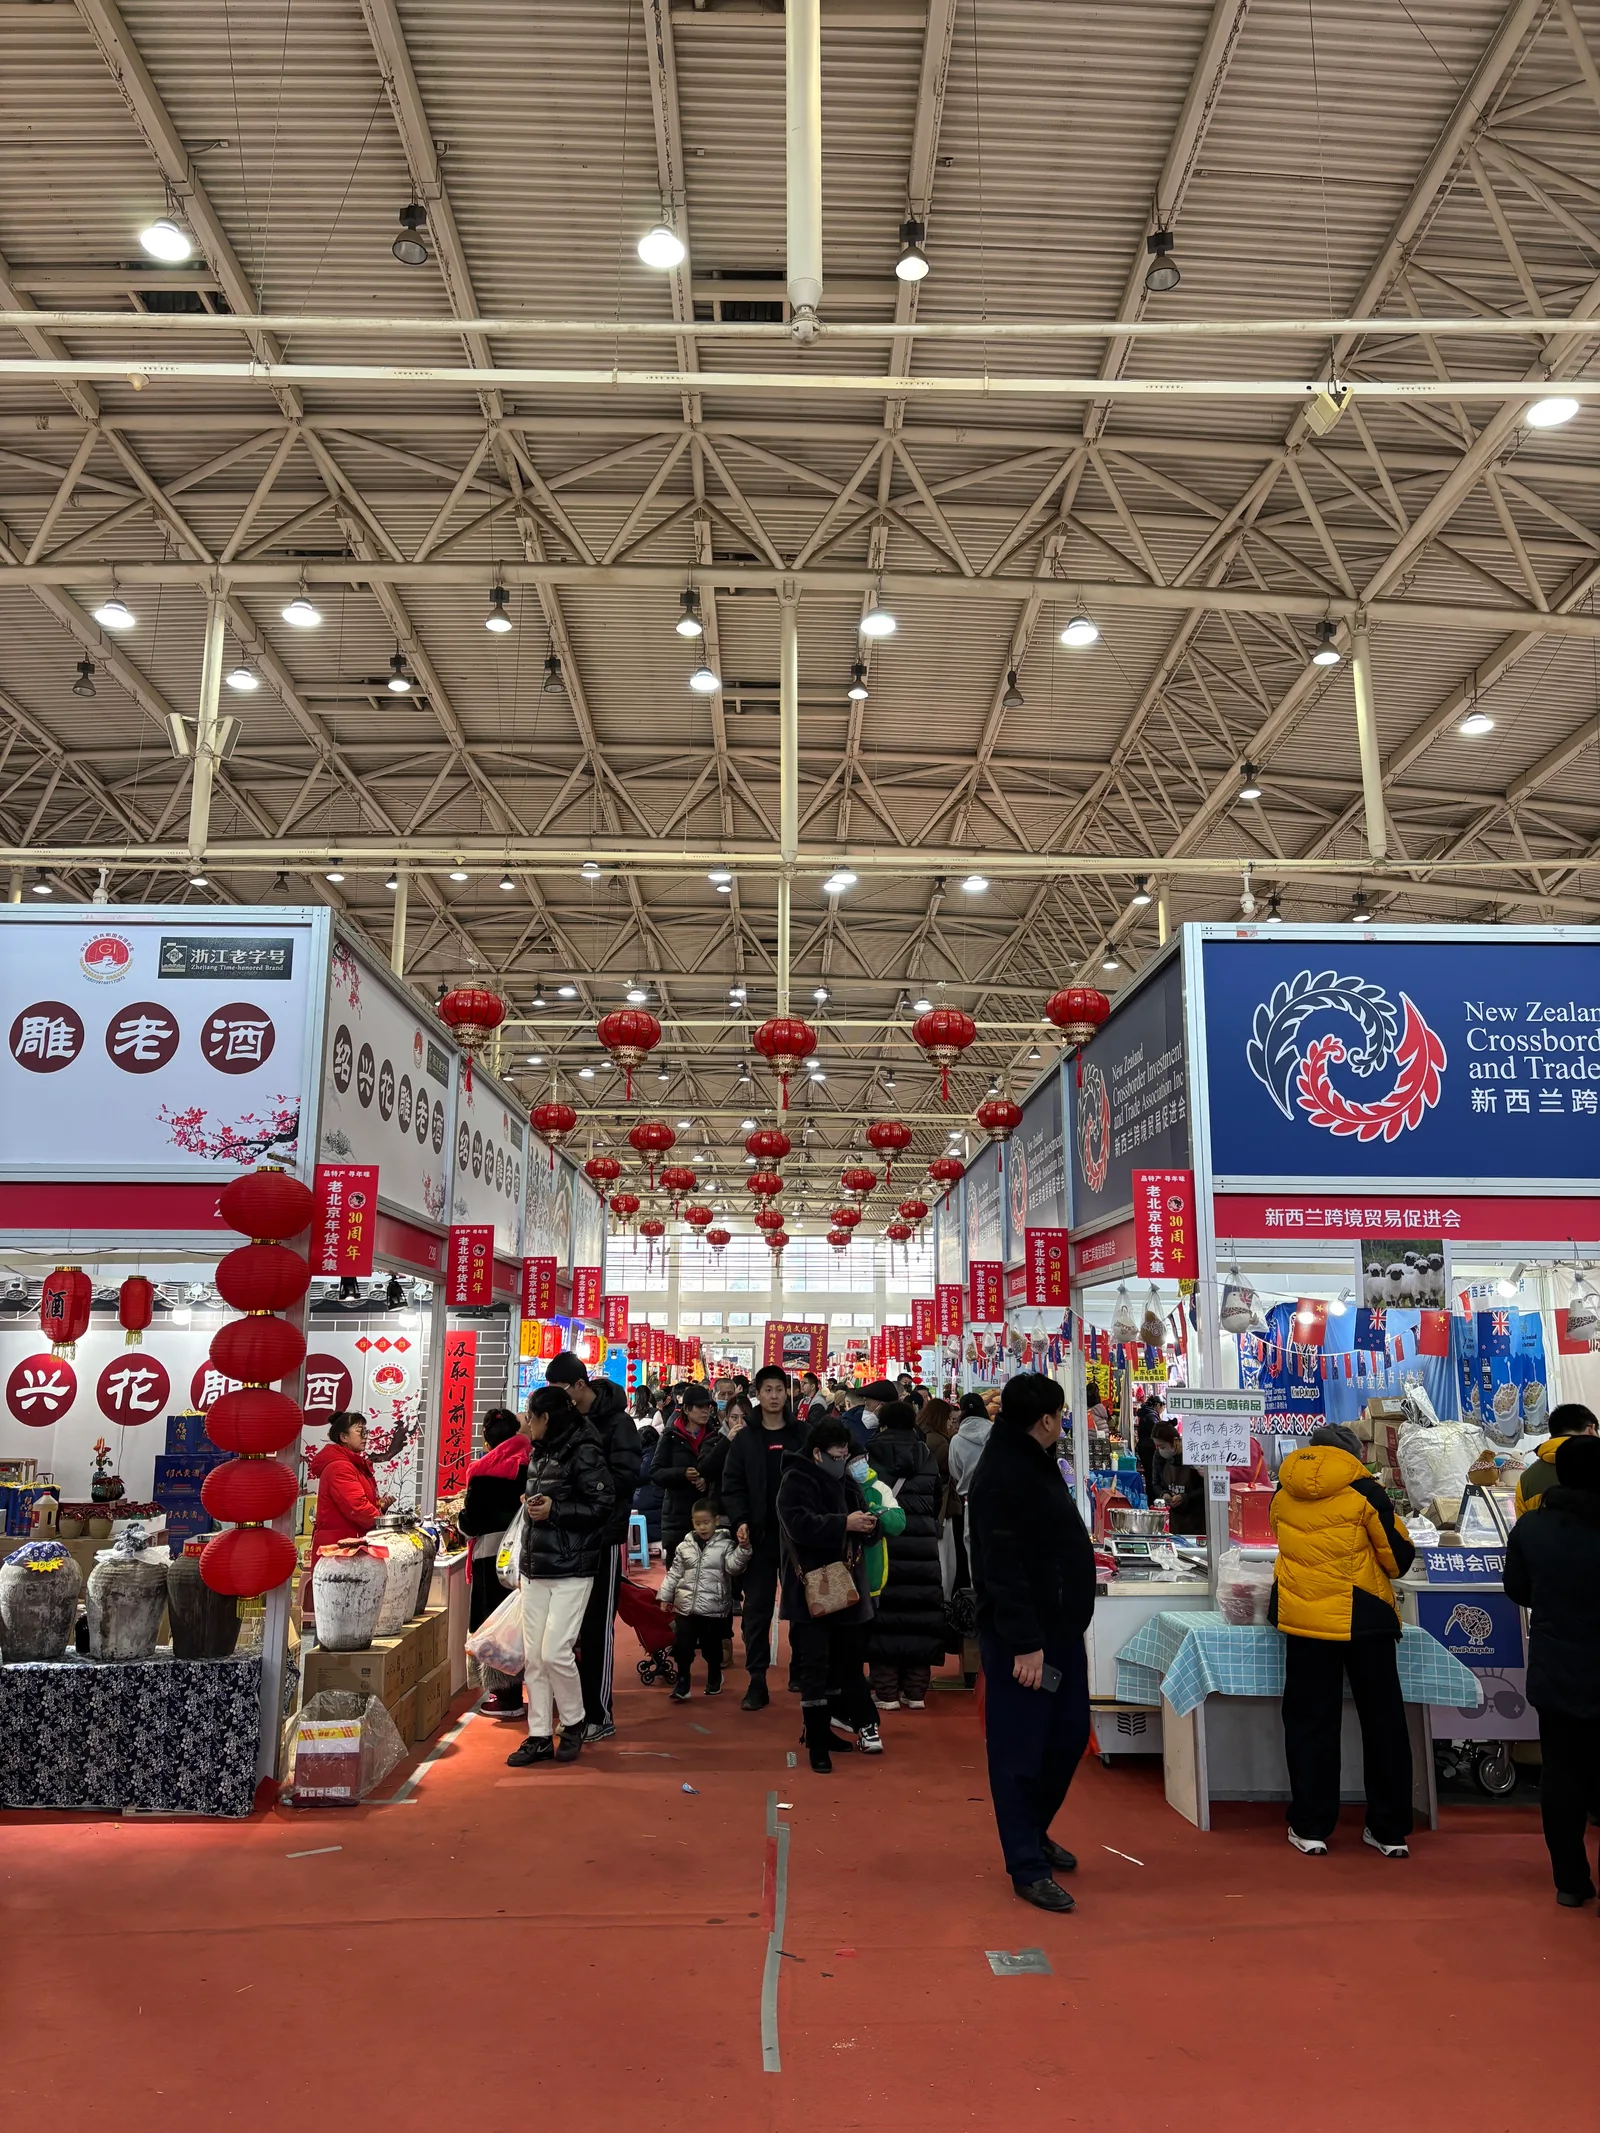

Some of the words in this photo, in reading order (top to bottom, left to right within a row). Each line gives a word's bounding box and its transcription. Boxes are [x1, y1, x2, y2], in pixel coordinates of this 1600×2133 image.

[98, 943, 116, 955] GI
[190, 949, 286, 965] 浙江老字号
[191, 964, 218, 972] Zhejiang
[220, 964, 263, 972] Time-honored
[265, 964, 284, 972] Brand
[1463, 1001, 1518, 1022] New
[1111, 1064, 1122, 1083] New
[1123, 1043, 1144, 1077] Zealand
[1112, 1069, 1146, 1107] Crossborder
[1147, 1041, 1183, 1082] Investment
[1469, 1055, 1517, 1080] and
[1524, 1055, 1600, 1080] Trade
[334, 1038, 444, 1146] 绍兴花雕老酒
[1113, 1107, 1125, 1130] and
[1125, 1097, 1141, 1127] Trade
[1142, 1081, 1172, 1113] Association
[1173, 1071, 1184, 1090] Inc
[1471, 1088, 1599, 1114] 新西兰跨
[1114, 1095, 1186, 1158] 新西兰跨境贸易促进会
[322, 1180, 343, 1271] 老北京年货大集
[345, 1212, 363, 1261] 30周年
[1145, 1185, 1165, 1274] 老北京年货大集
[1265, 1208, 1461, 1229] 新西兰跨境贸易促进会
[1169, 1215, 1186, 1264] 30周年
[456, 1237, 469, 1302] 老北京年货大集
[472, 1258, 485, 1294] 30周年
[1033, 1239, 1047, 1303] 老北京年货大集
[1049, 1261, 1062, 1296] 30周年
[45, 1289, 67, 1320] 酒
[528, 1266, 538, 1317] 老北京年货大集
[976, 1270, 986, 1320] 老北京年货大集
[941, 1291, 949, 1333] 老北京年货大集
[1170, 1397, 1262, 1411] 进口博览会畅销品
[1186, 1438, 1247, 1452] 新西兰羊汤
[1190, 1420, 1243, 1436] 有肉有汤
[1427, 1553, 1507, 1573] 进博会同
